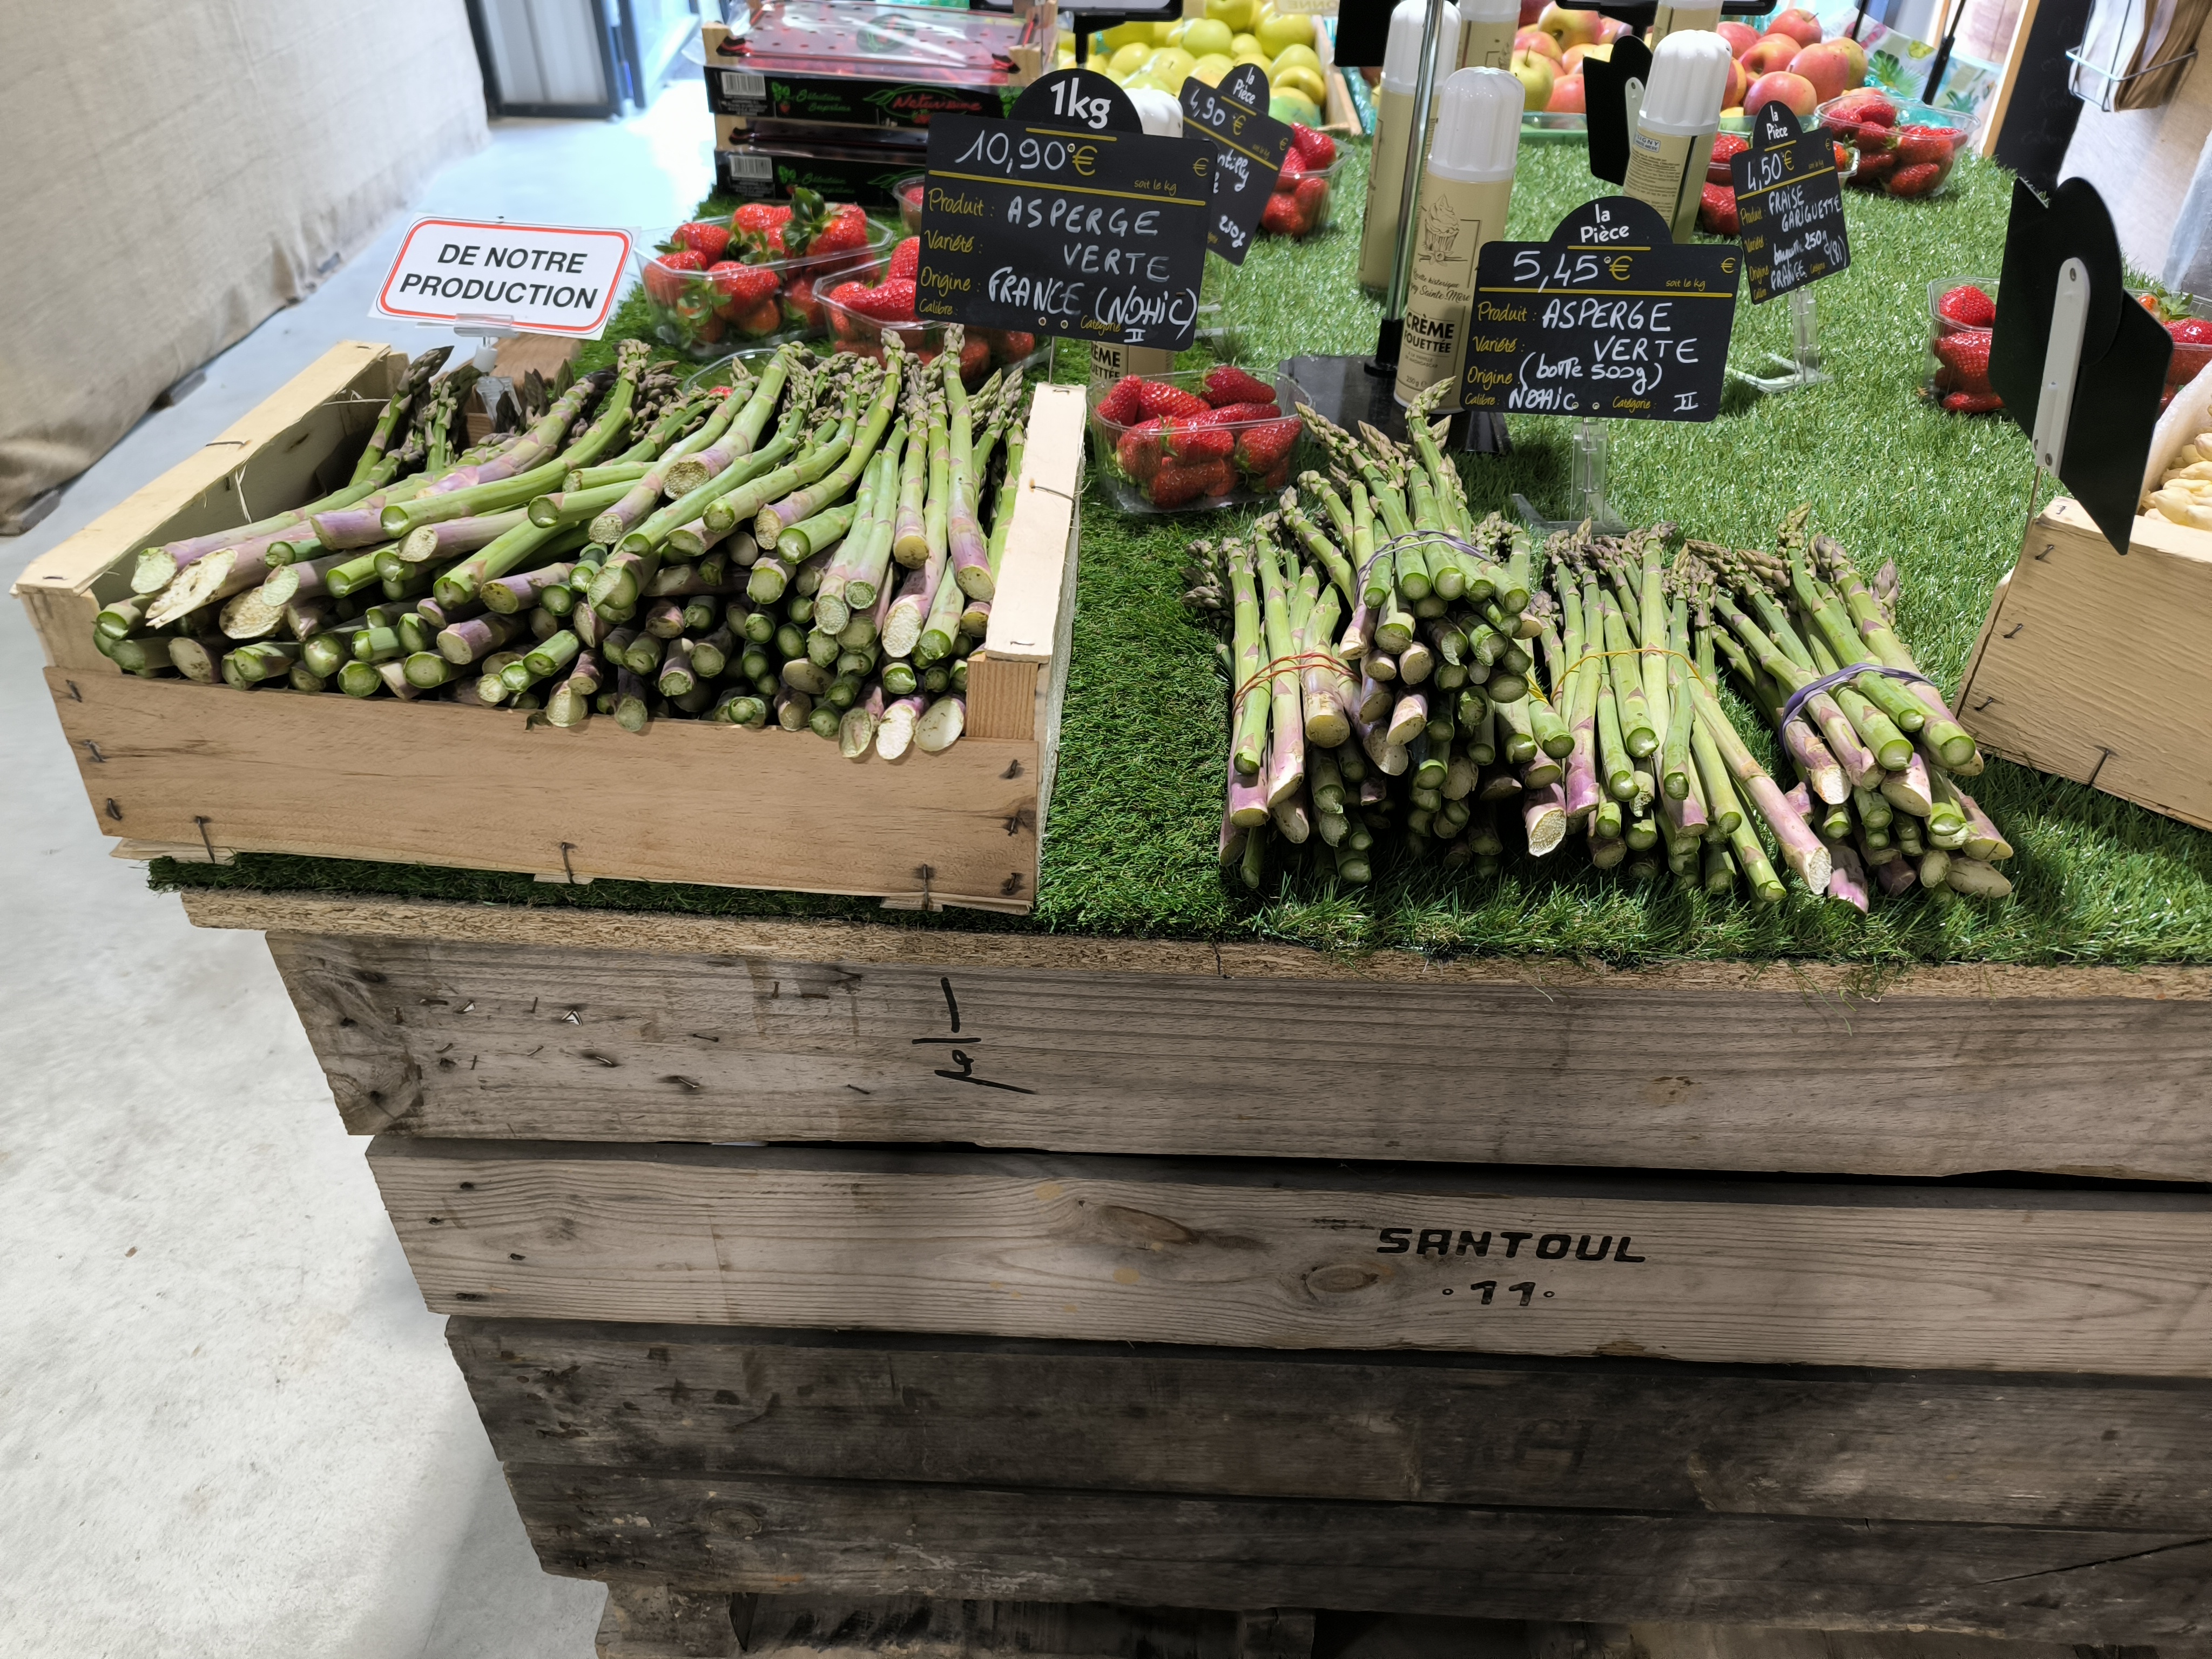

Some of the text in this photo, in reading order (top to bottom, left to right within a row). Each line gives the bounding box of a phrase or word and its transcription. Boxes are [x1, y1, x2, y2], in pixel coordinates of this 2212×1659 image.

[1246, 66, 1255, 85] la
[1051, 78, 1111, 129] 1kg
[1232, 78, 1256, 105] Pièce
[1770, 105, 1779, 122] la
[1637, 134, 1659, 146] SIGNY
[1766, 123, 1789, 140] Pièce
[1217, 149, 1250, 192] ntilly
[1747, 153, 1782, 192] 4,50
[1153, 180, 1162, 190] le
[1164, 183, 1177, 195] kg
[1007, 195, 1160, 237] ASPERGE
[1595, 204, 1610, 224] la
[1580, 223, 1630, 244] Pièce
[437, 243, 588, 274] DE NOTRE
[1064, 242, 1170, 282] VERTE
[1513, 251, 1598, 293] 5,45
[399, 273, 598, 309] PRODUCTION
[988, 266, 1085, 315] FRANCE
[1684, 279, 1692, 288] le
[1694, 279, 1706, 292] kg
[1406, 312, 1455, 339] CRÈME
[1542, 298, 1673, 332] ASPERGE
[1594, 335, 1699, 363] VERTE
[1377, 1228, 1645, 1263] SANTOUL
